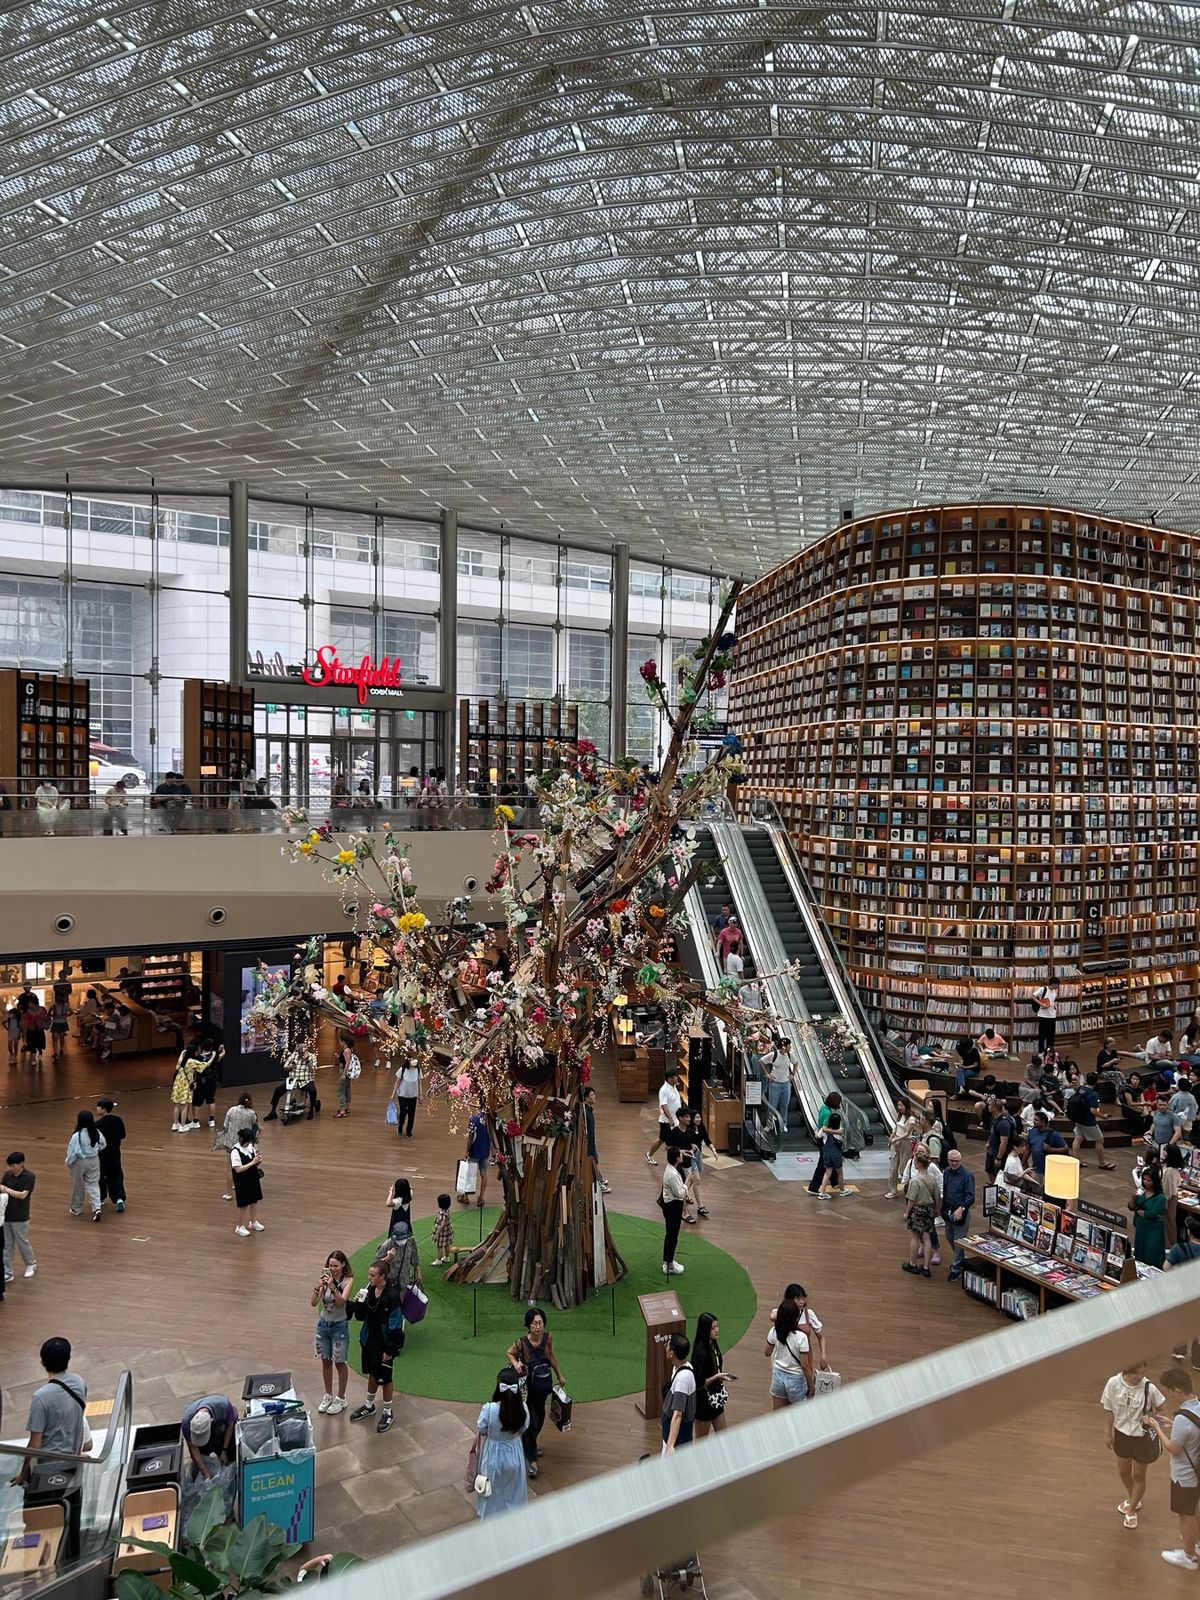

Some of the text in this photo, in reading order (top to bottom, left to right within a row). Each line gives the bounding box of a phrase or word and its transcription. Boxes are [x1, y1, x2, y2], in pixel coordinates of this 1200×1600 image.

[302, 644, 401, 705] Starfield
[26, 683, 34, 695] G
[388, 689, 404, 697] MALL
[1089, 906, 1098, 918] C
[251, 1474, 295, 1492] CLEAN
